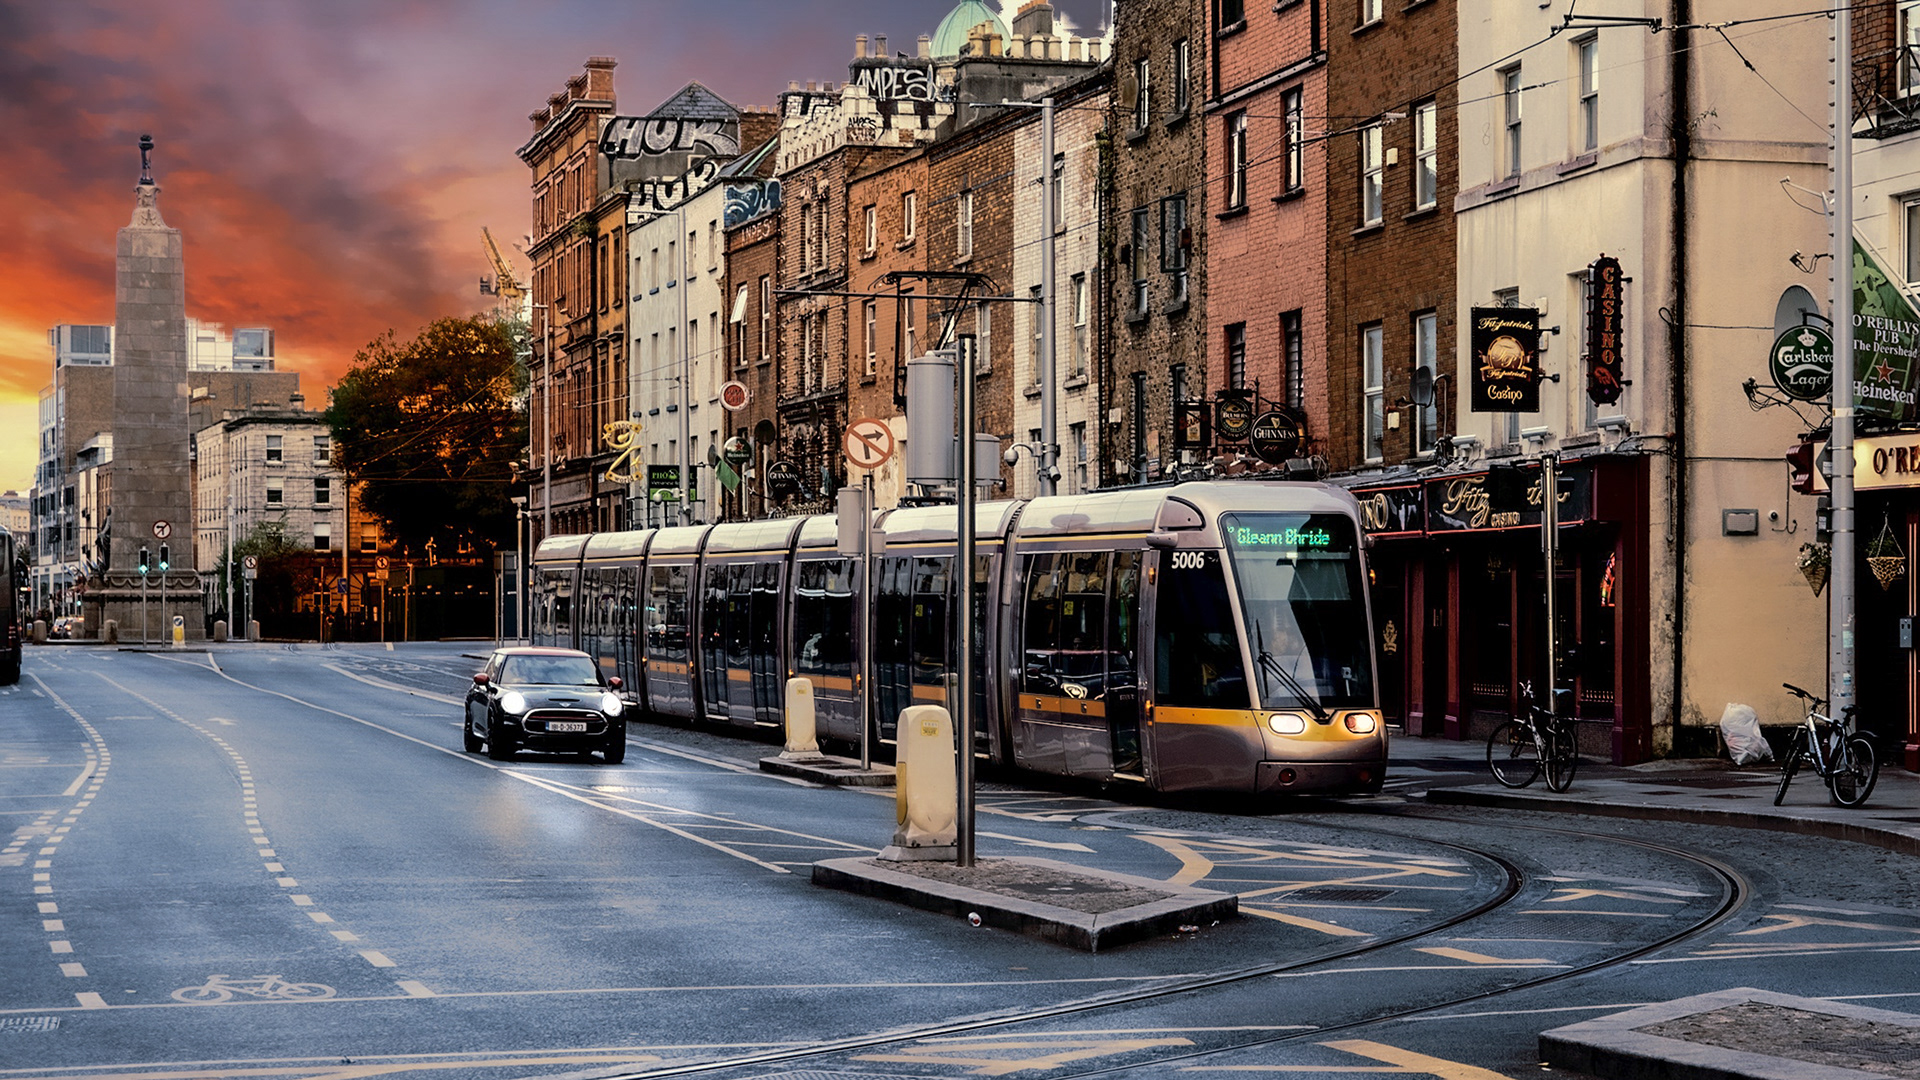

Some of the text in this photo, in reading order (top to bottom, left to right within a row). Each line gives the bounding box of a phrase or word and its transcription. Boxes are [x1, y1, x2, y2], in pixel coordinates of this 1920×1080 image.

[1478, 317, 1533, 332] Fitzpatricks
[1601, 267, 1616, 365] CASINO
[1852, 314, 1919, 335] O'REILLYS
[1875, 329, 1900, 344] PUB
[1853, 340, 1918, 358] The Deershead
[1789, 375, 1829, 391] Lager
[1488, 385, 1523, 405] Casino
[1853, 381, 1915, 404] Heineken
[1254, 428, 1296, 439] GUINNESS
[1237, 527, 1283, 545] Gleann
[1171, 551, 1205, 569] 5006
